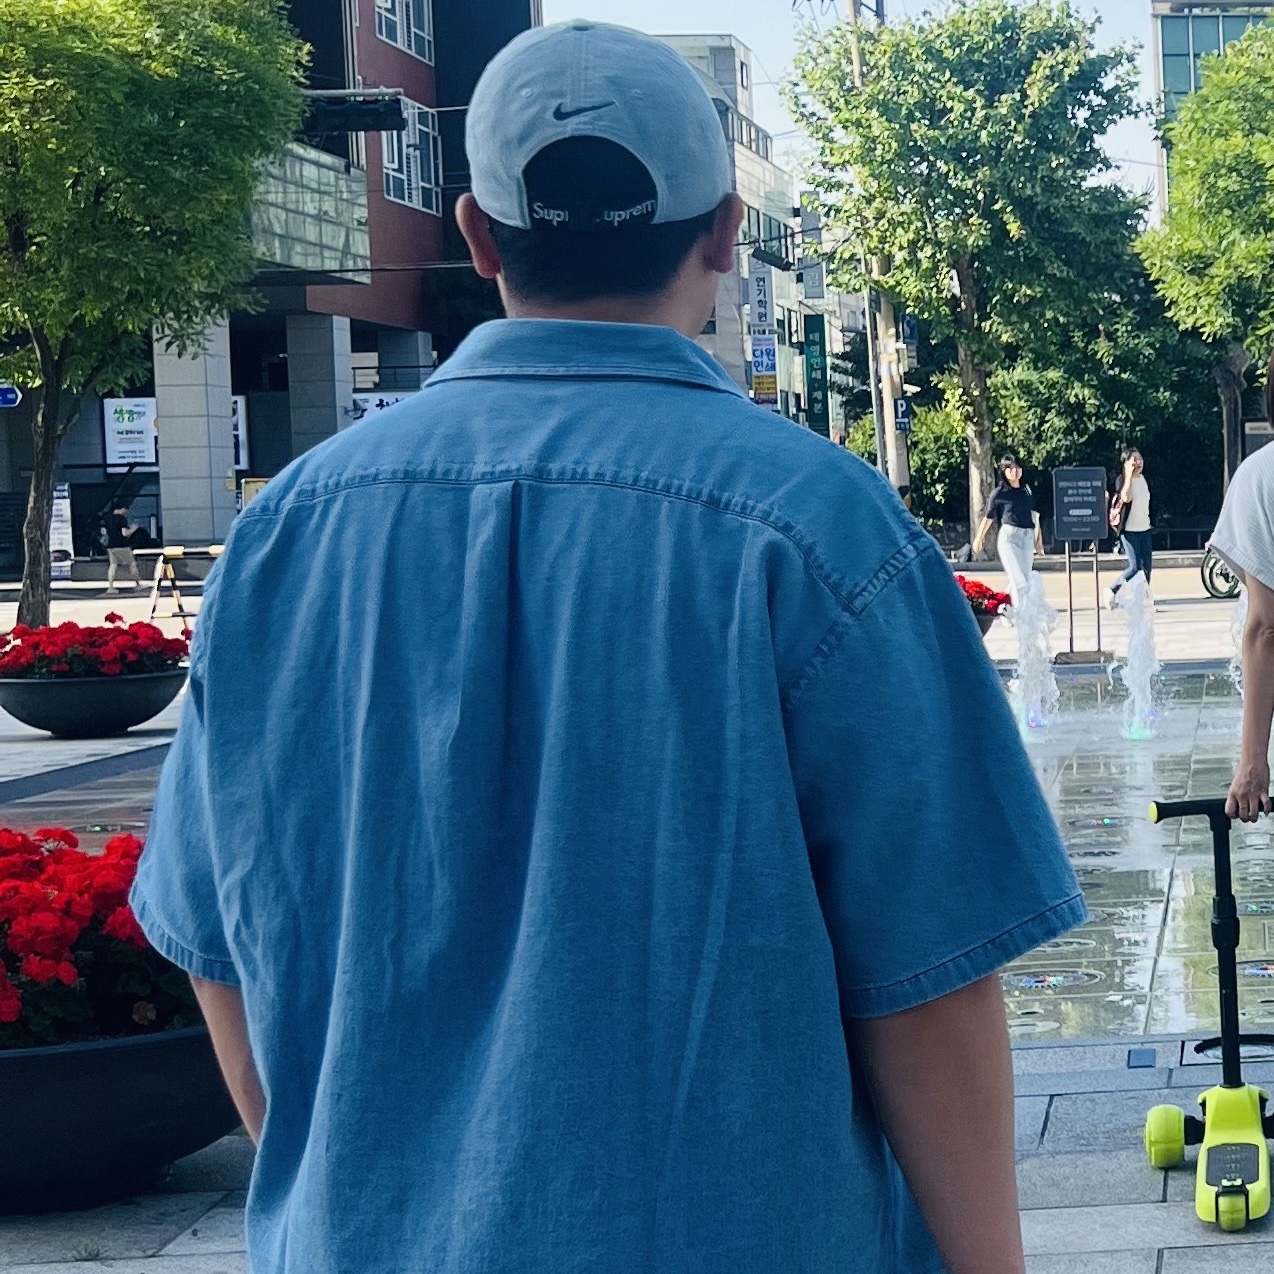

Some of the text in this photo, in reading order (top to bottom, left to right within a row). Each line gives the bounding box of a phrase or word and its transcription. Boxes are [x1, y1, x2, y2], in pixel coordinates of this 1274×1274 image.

[596, 199, 656, 226] uprem
[755, 276, 768, 323] 연기학원
[897, 399, 907, 418] P
